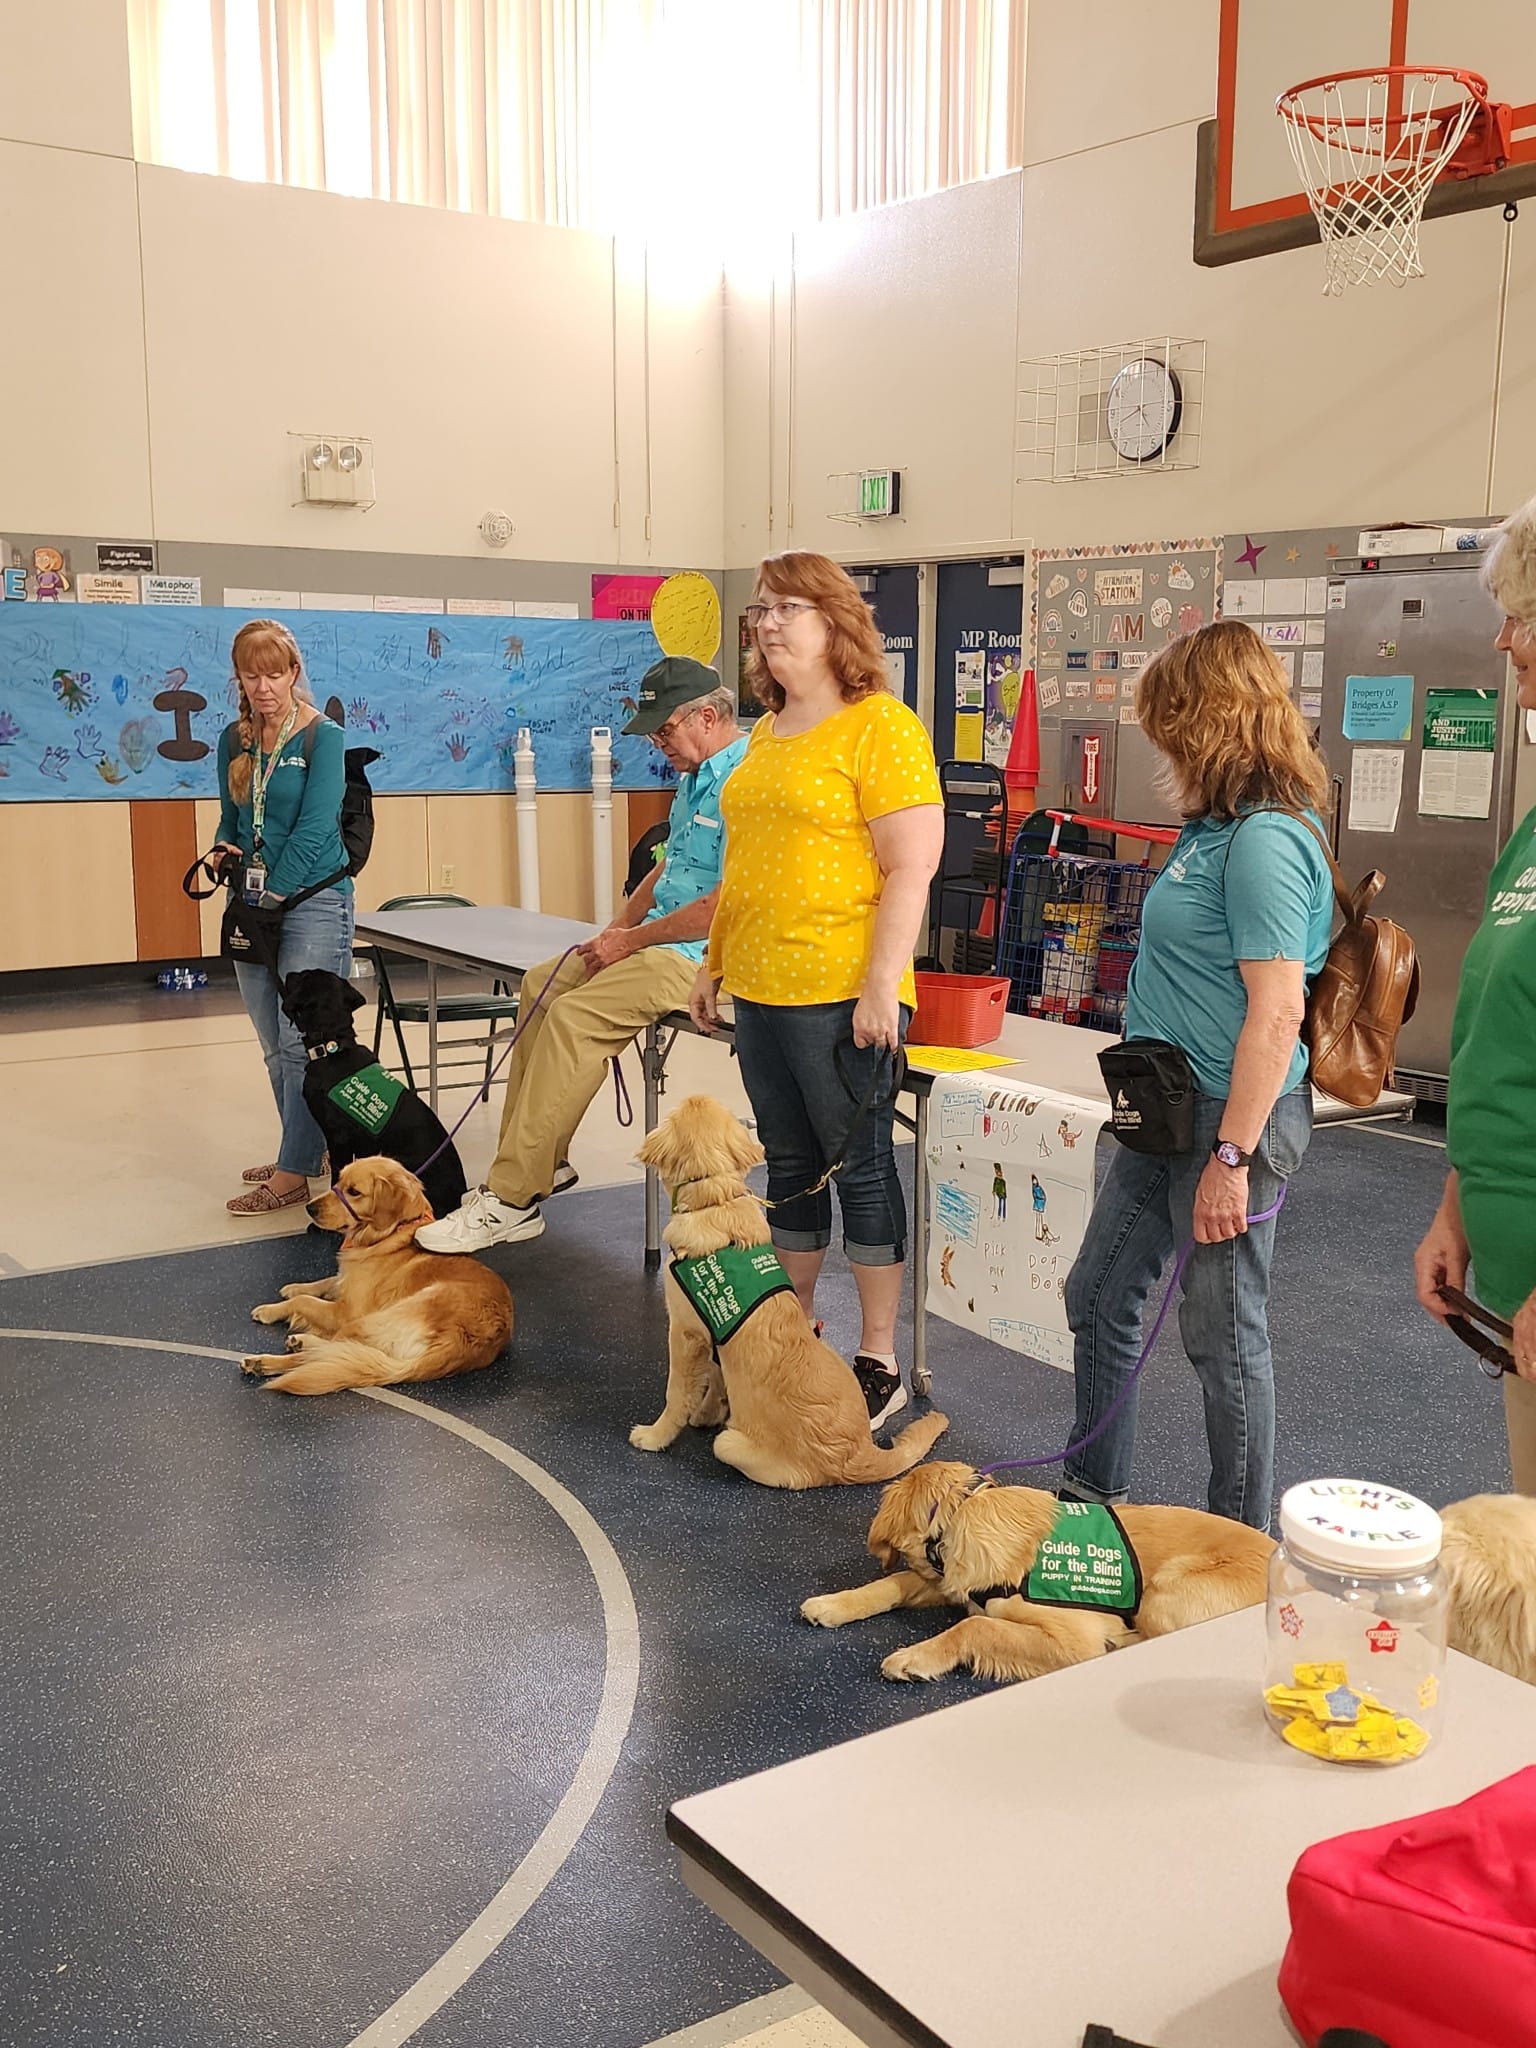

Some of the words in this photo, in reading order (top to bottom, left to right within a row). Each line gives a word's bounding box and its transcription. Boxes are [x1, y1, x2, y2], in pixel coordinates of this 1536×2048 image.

[862, 476, 887, 511] EXIT
[4, 568, 27, 601] E
[94, 579, 124, 589] Simile
[150, 580, 195, 591] Metaphor
[1100, 586, 1136, 600] STATION
[620, 608, 634, 620] ON
[1107, 612, 1145, 643] AM
[960, 631, 985, 648] MP
[1352, 688, 1384, 699] Property
[1351, 701, 1379, 711] Bridges
[1430, 726, 1467, 735] JUSTICE
[1440, 733, 1456, 742] ALL
[370, 1092, 389, 1112] Dogs
[696, 1260, 709, 1277] for
[706, 1278, 718, 1296] the
[716, 1296, 733, 1322] Blind
[707, 1254, 725, 1284] Guide
[723, 1285, 741, 1315] Dogs
[1309, 1486, 1416, 1510] LIGHTS
[1306, 1515, 1422, 1541] RAFFLE
[1042, 1540, 1081, 1556] Guide
[1087, 1544, 1122, 1562] Dogs
[1041, 1556, 1062, 1571] for
[1067, 1559, 1088, 1573] the
[1093, 1560, 1122, 1577] Blind
[1041, 1572, 1070, 1582] PUPPY
[1073, 1574, 1082, 1583] IN
[1085, 1576, 1122, 1587] TRAINING
